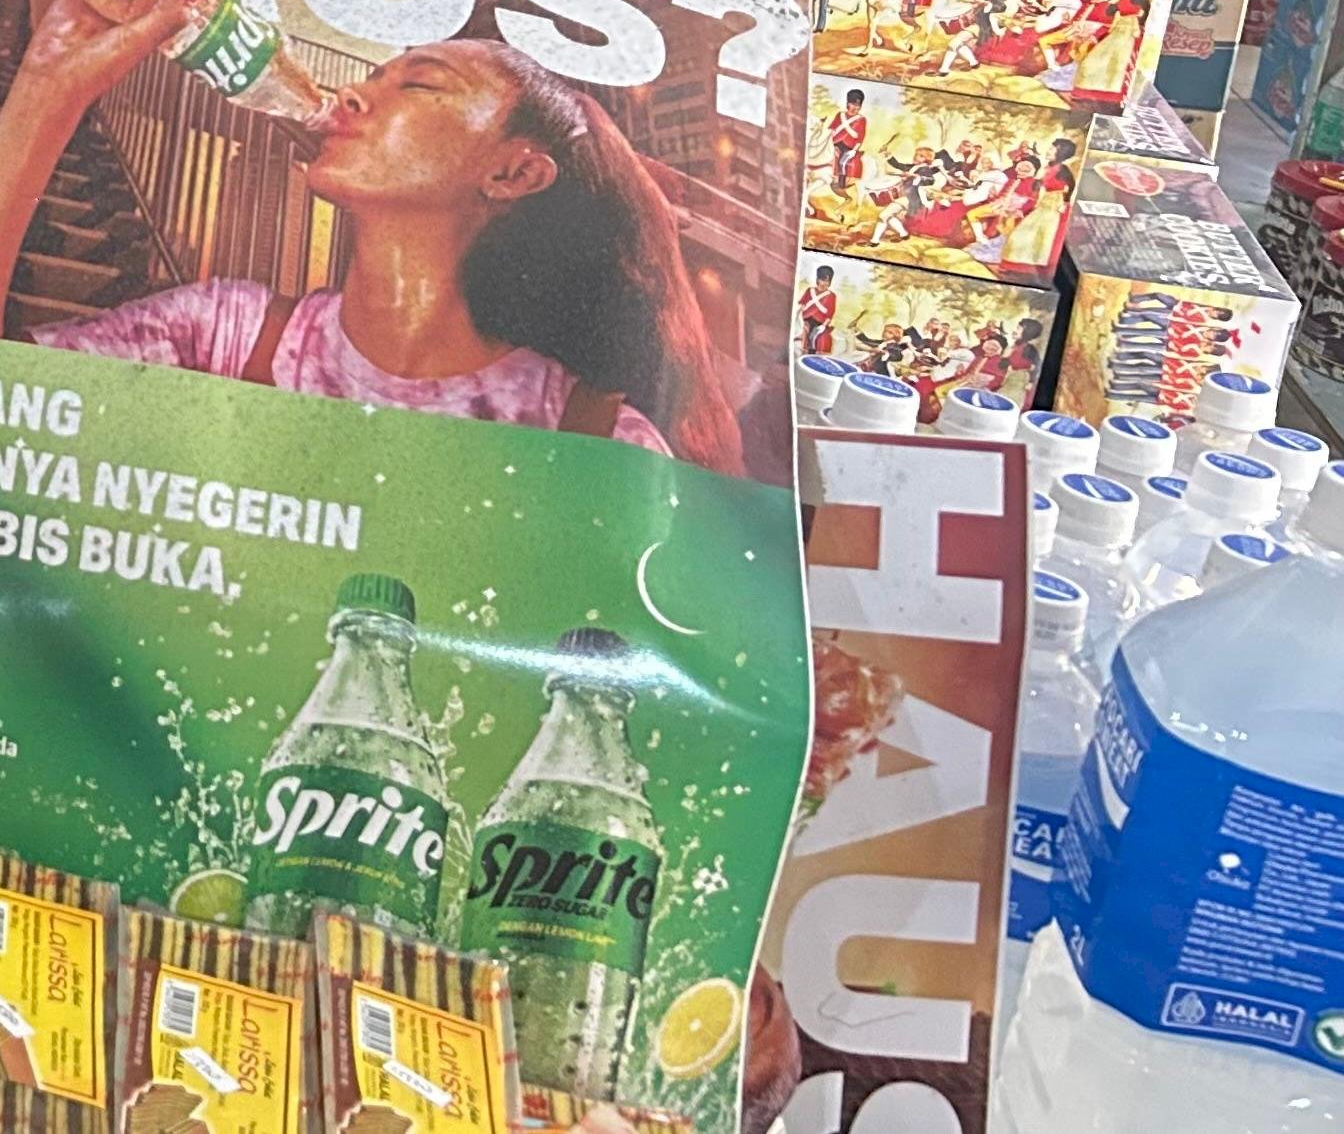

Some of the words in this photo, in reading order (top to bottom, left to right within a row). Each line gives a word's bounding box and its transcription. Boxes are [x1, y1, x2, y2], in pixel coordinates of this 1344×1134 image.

[92, 461, 364, 551] NYEGERIN
[252, 775, 446, 877] Sprite
[466, 831, 657, 921] Sprite
[506, 894, 553, 912] ZERO
[47, 912, 82, 1004] Larissa
[1214, 1000, 1293, 1030] HALAL
